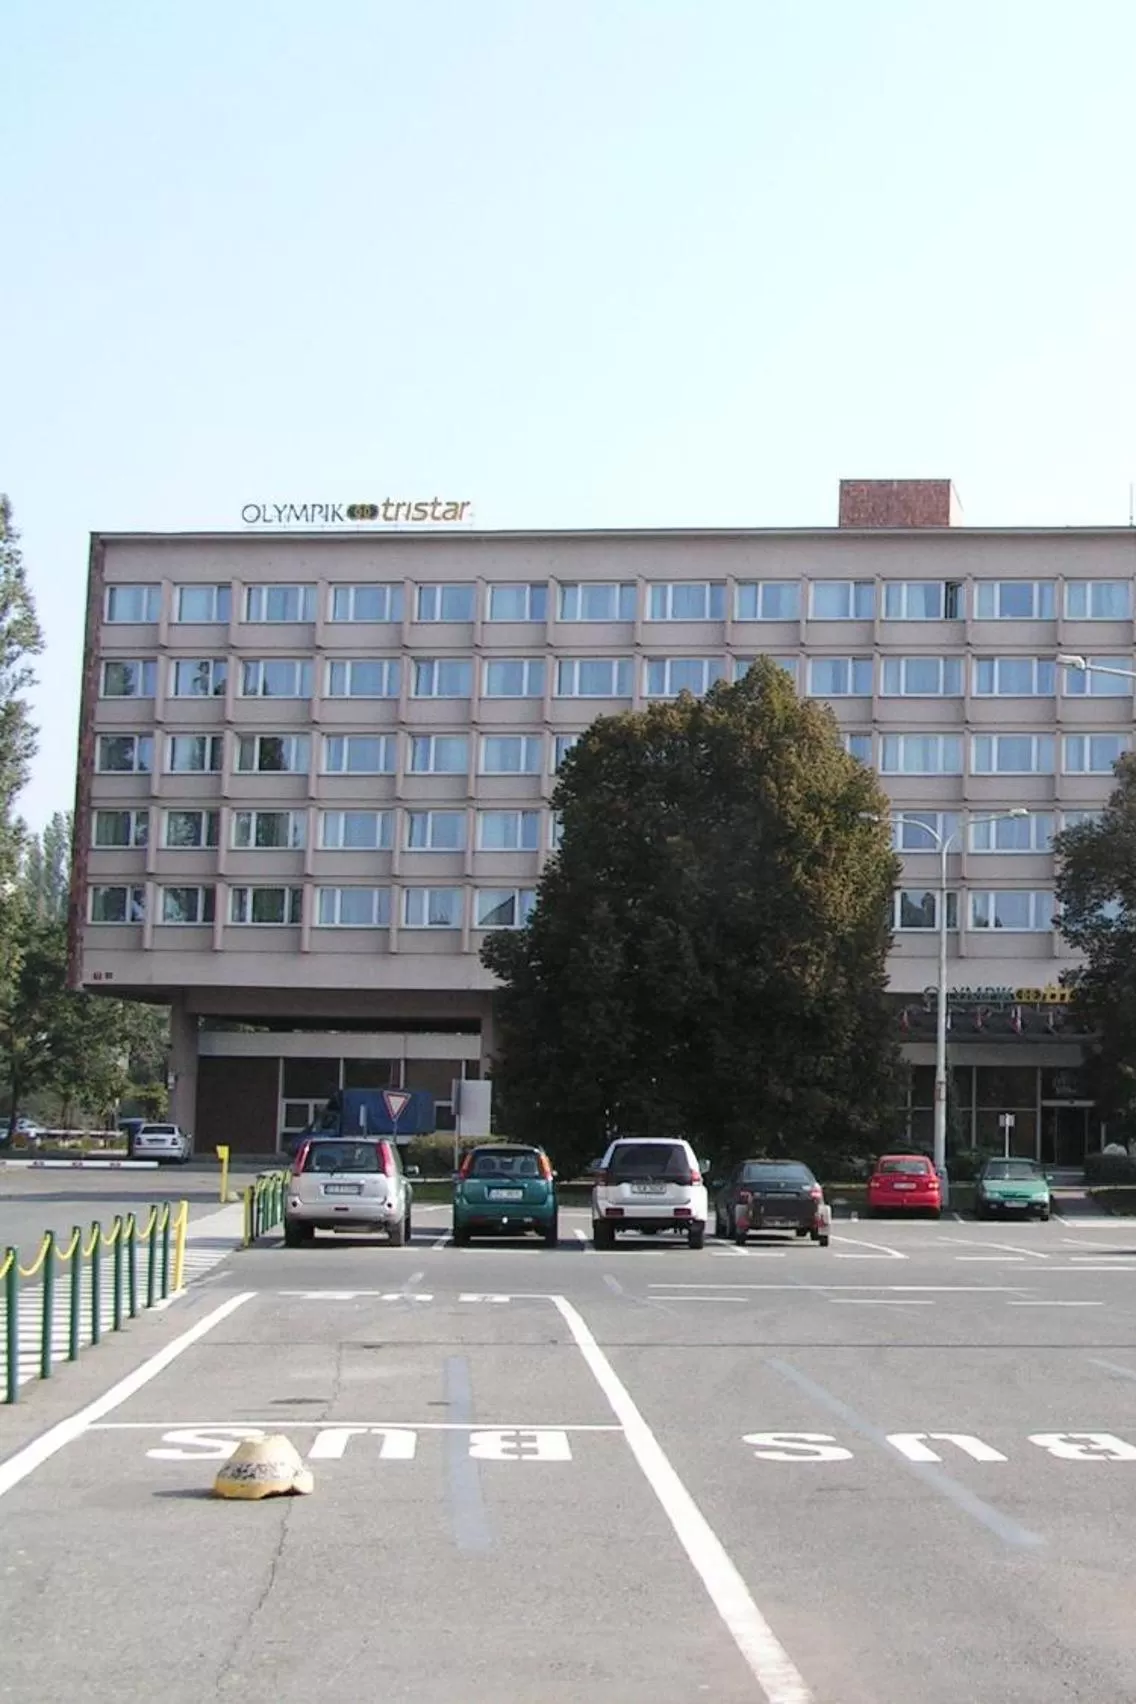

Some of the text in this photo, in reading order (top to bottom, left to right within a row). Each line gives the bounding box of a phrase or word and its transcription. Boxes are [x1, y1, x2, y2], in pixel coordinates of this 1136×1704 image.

[241, 497, 471, 524] OLYMPIK tristar
[145, 1427, 572, 1461] BUS
